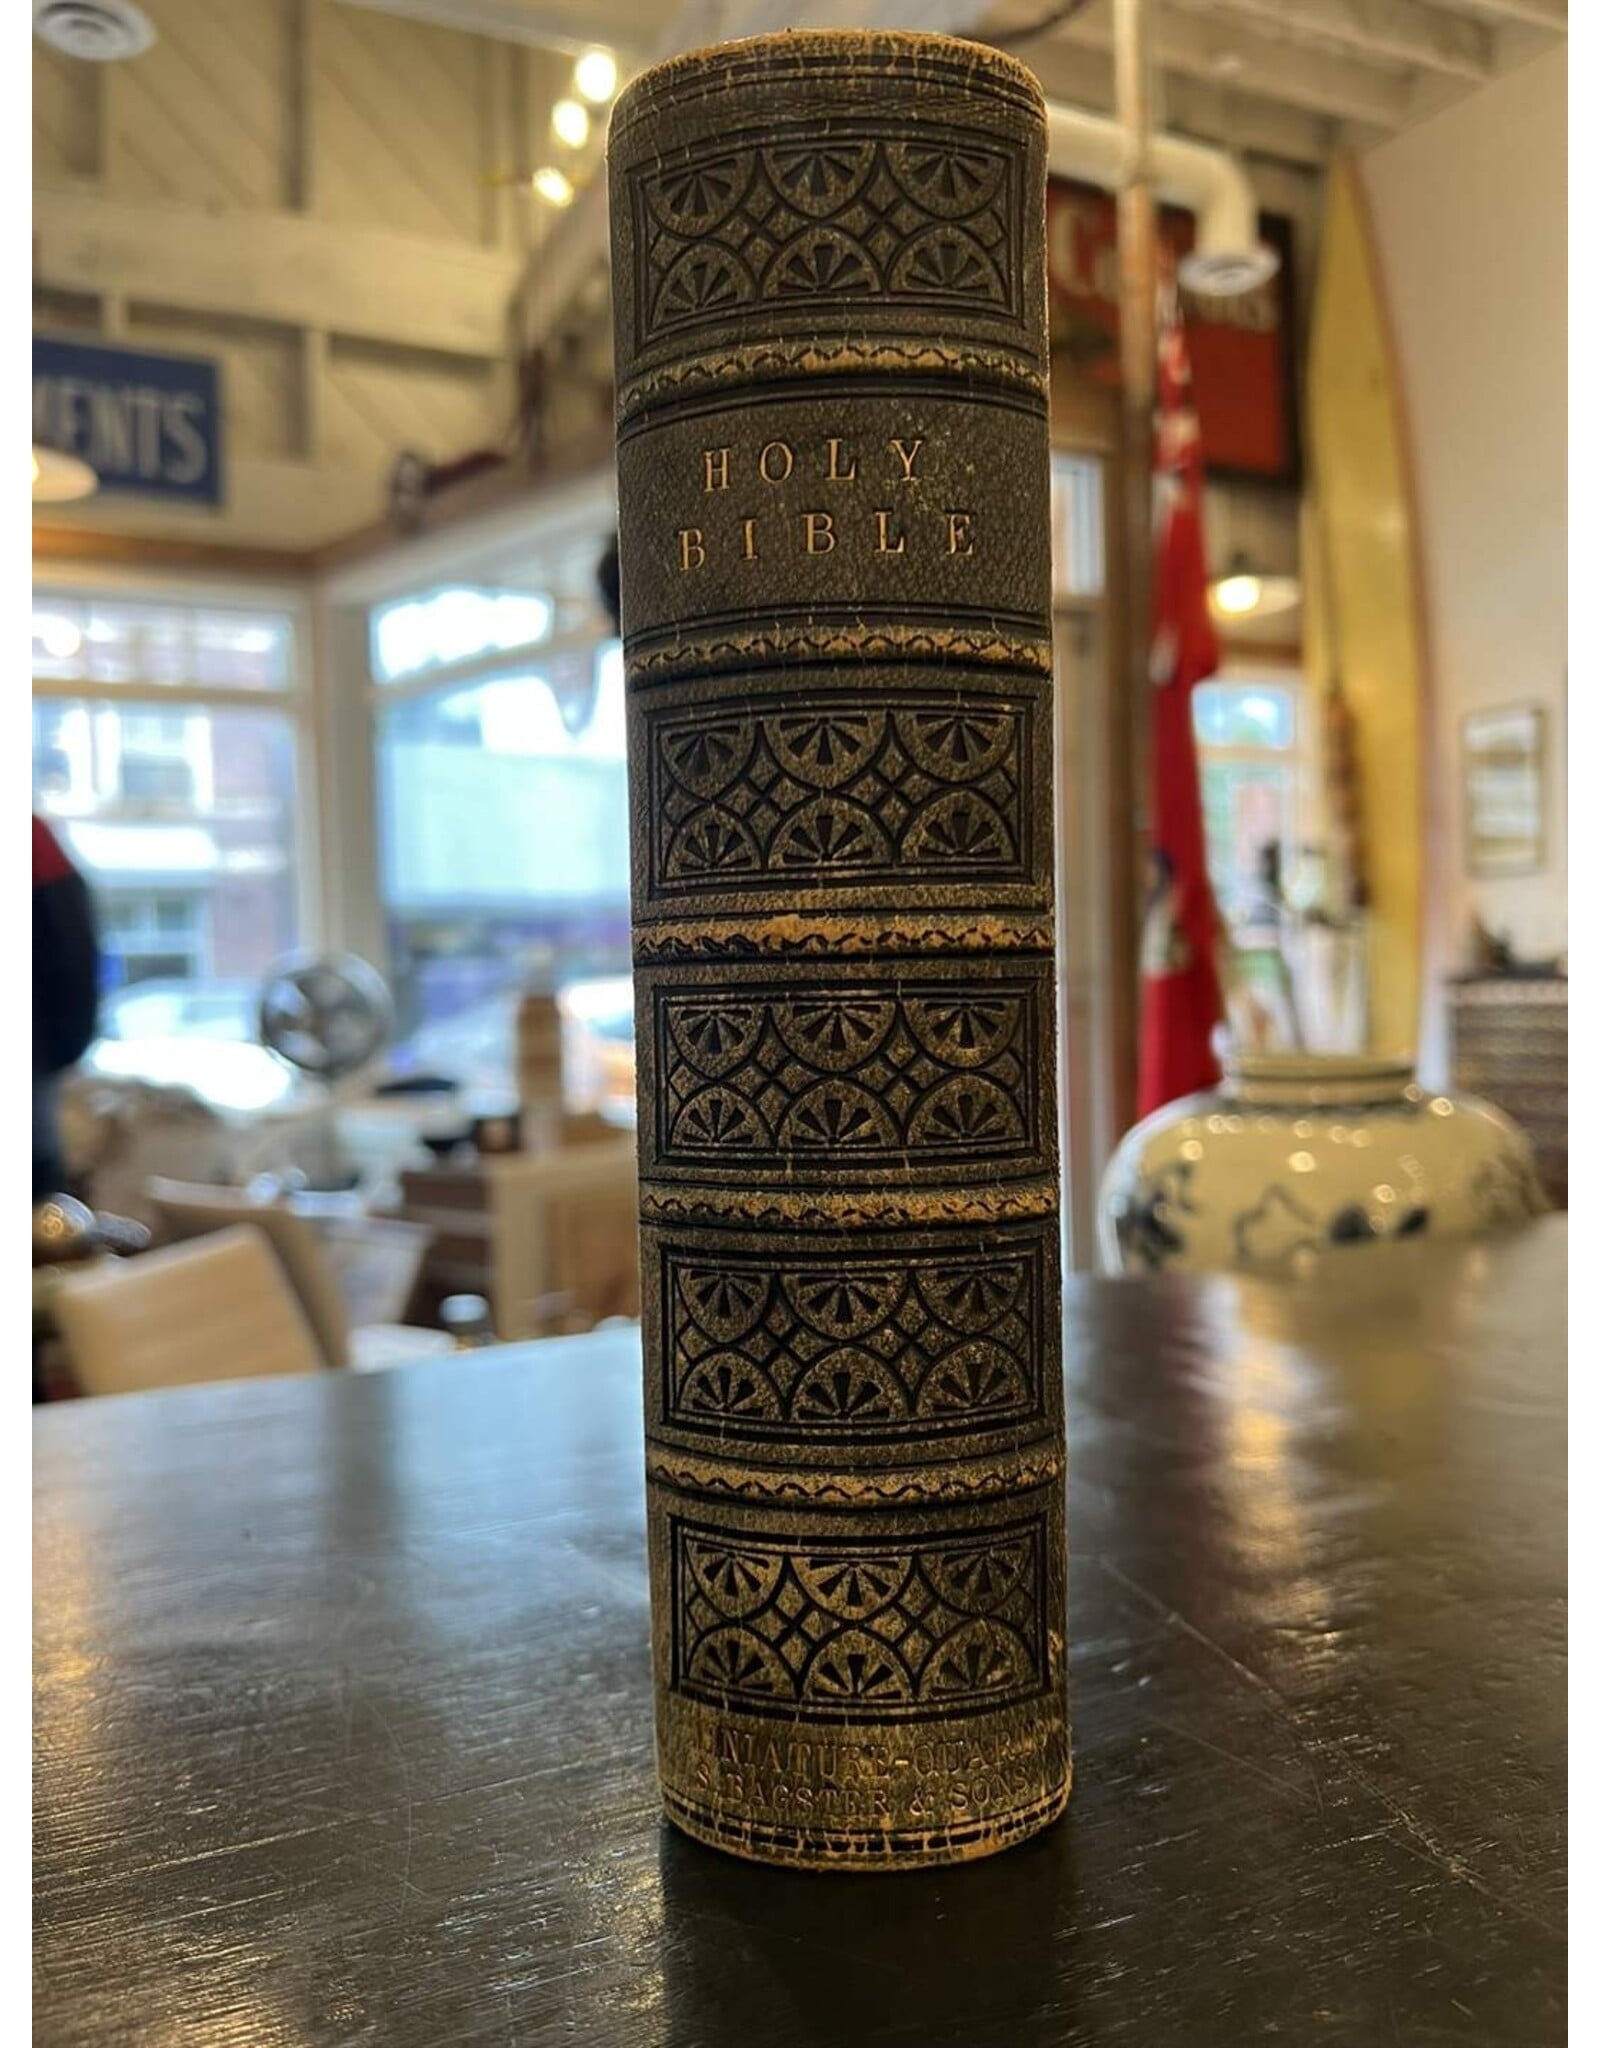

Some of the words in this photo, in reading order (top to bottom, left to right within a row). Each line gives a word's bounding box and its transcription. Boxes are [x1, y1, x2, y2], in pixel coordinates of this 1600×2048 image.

[703, 437, 923, 492] HOLY
[678, 510, 974, 572] BIBLE
[908, 1785, 936, 1817] &
[949, 1764, 1029, 1812] SONS
